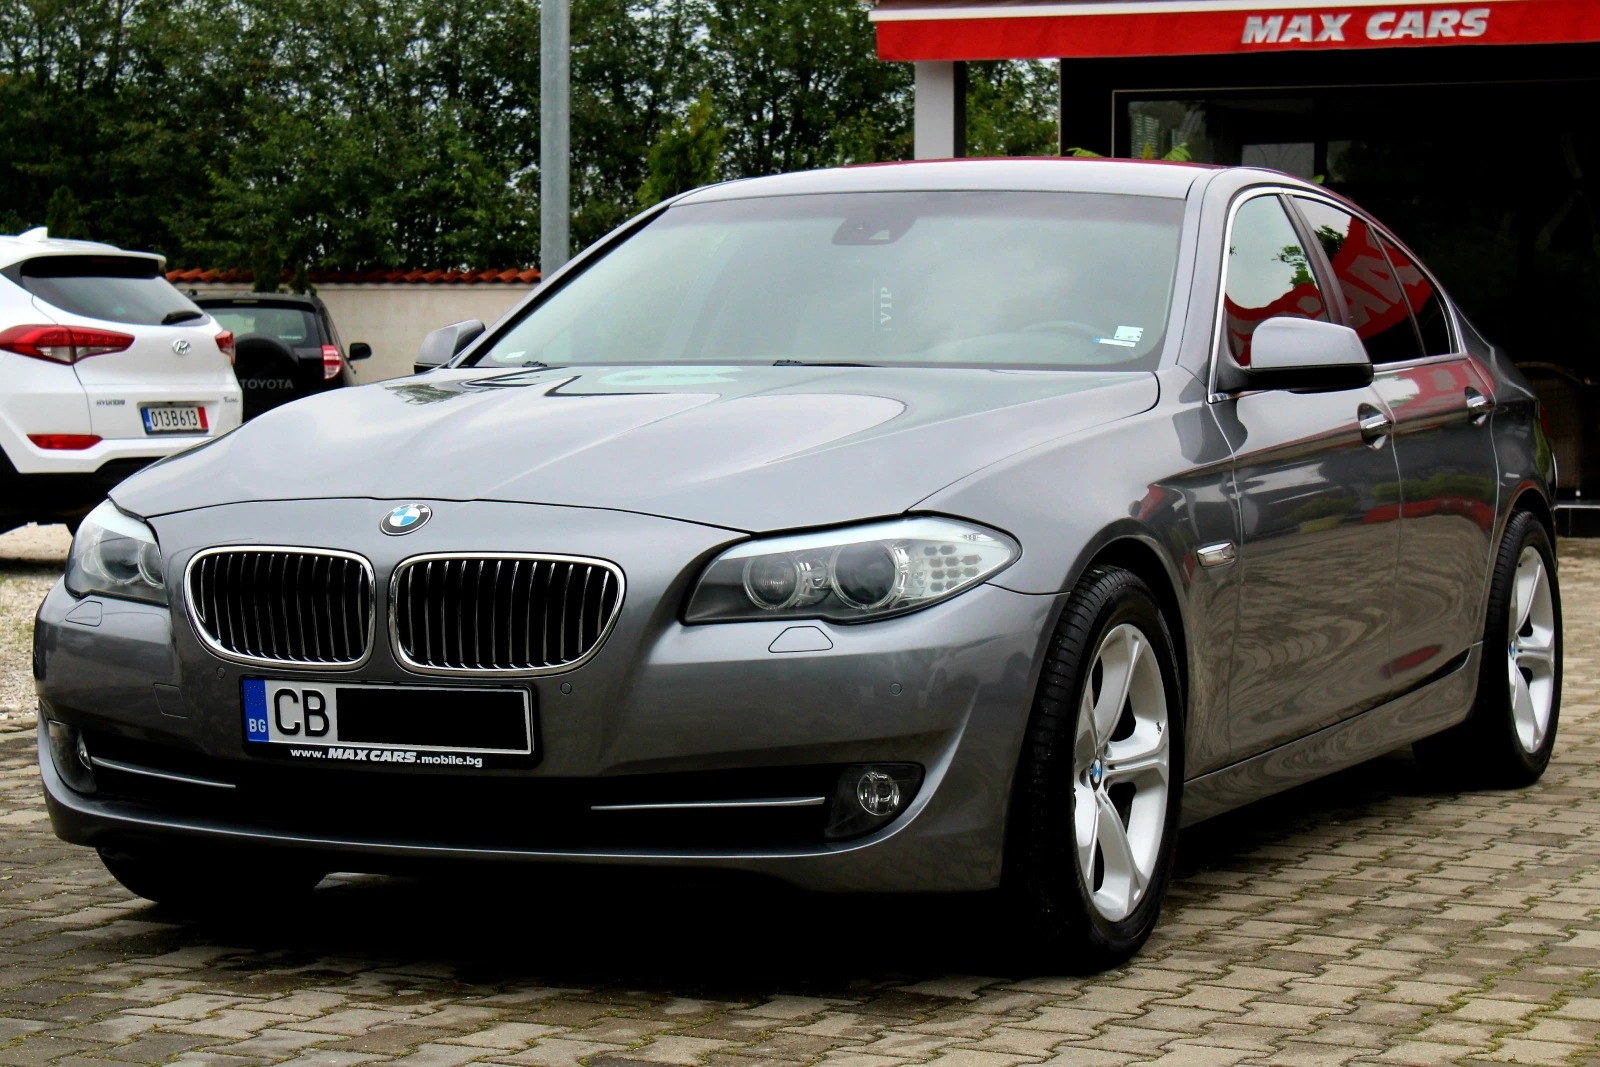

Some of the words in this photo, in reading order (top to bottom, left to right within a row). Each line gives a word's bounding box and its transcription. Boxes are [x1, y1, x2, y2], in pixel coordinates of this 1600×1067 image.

[1241, 14, 1351, 44] MAX
[1365, 8, 1491, 40] CARS
[240, 378, 294, 390] TOYOTA
[150, 410, 198, 427] 013B613
[273, 687, 330, 737] CB
[248, 718, 267, 733] BG
